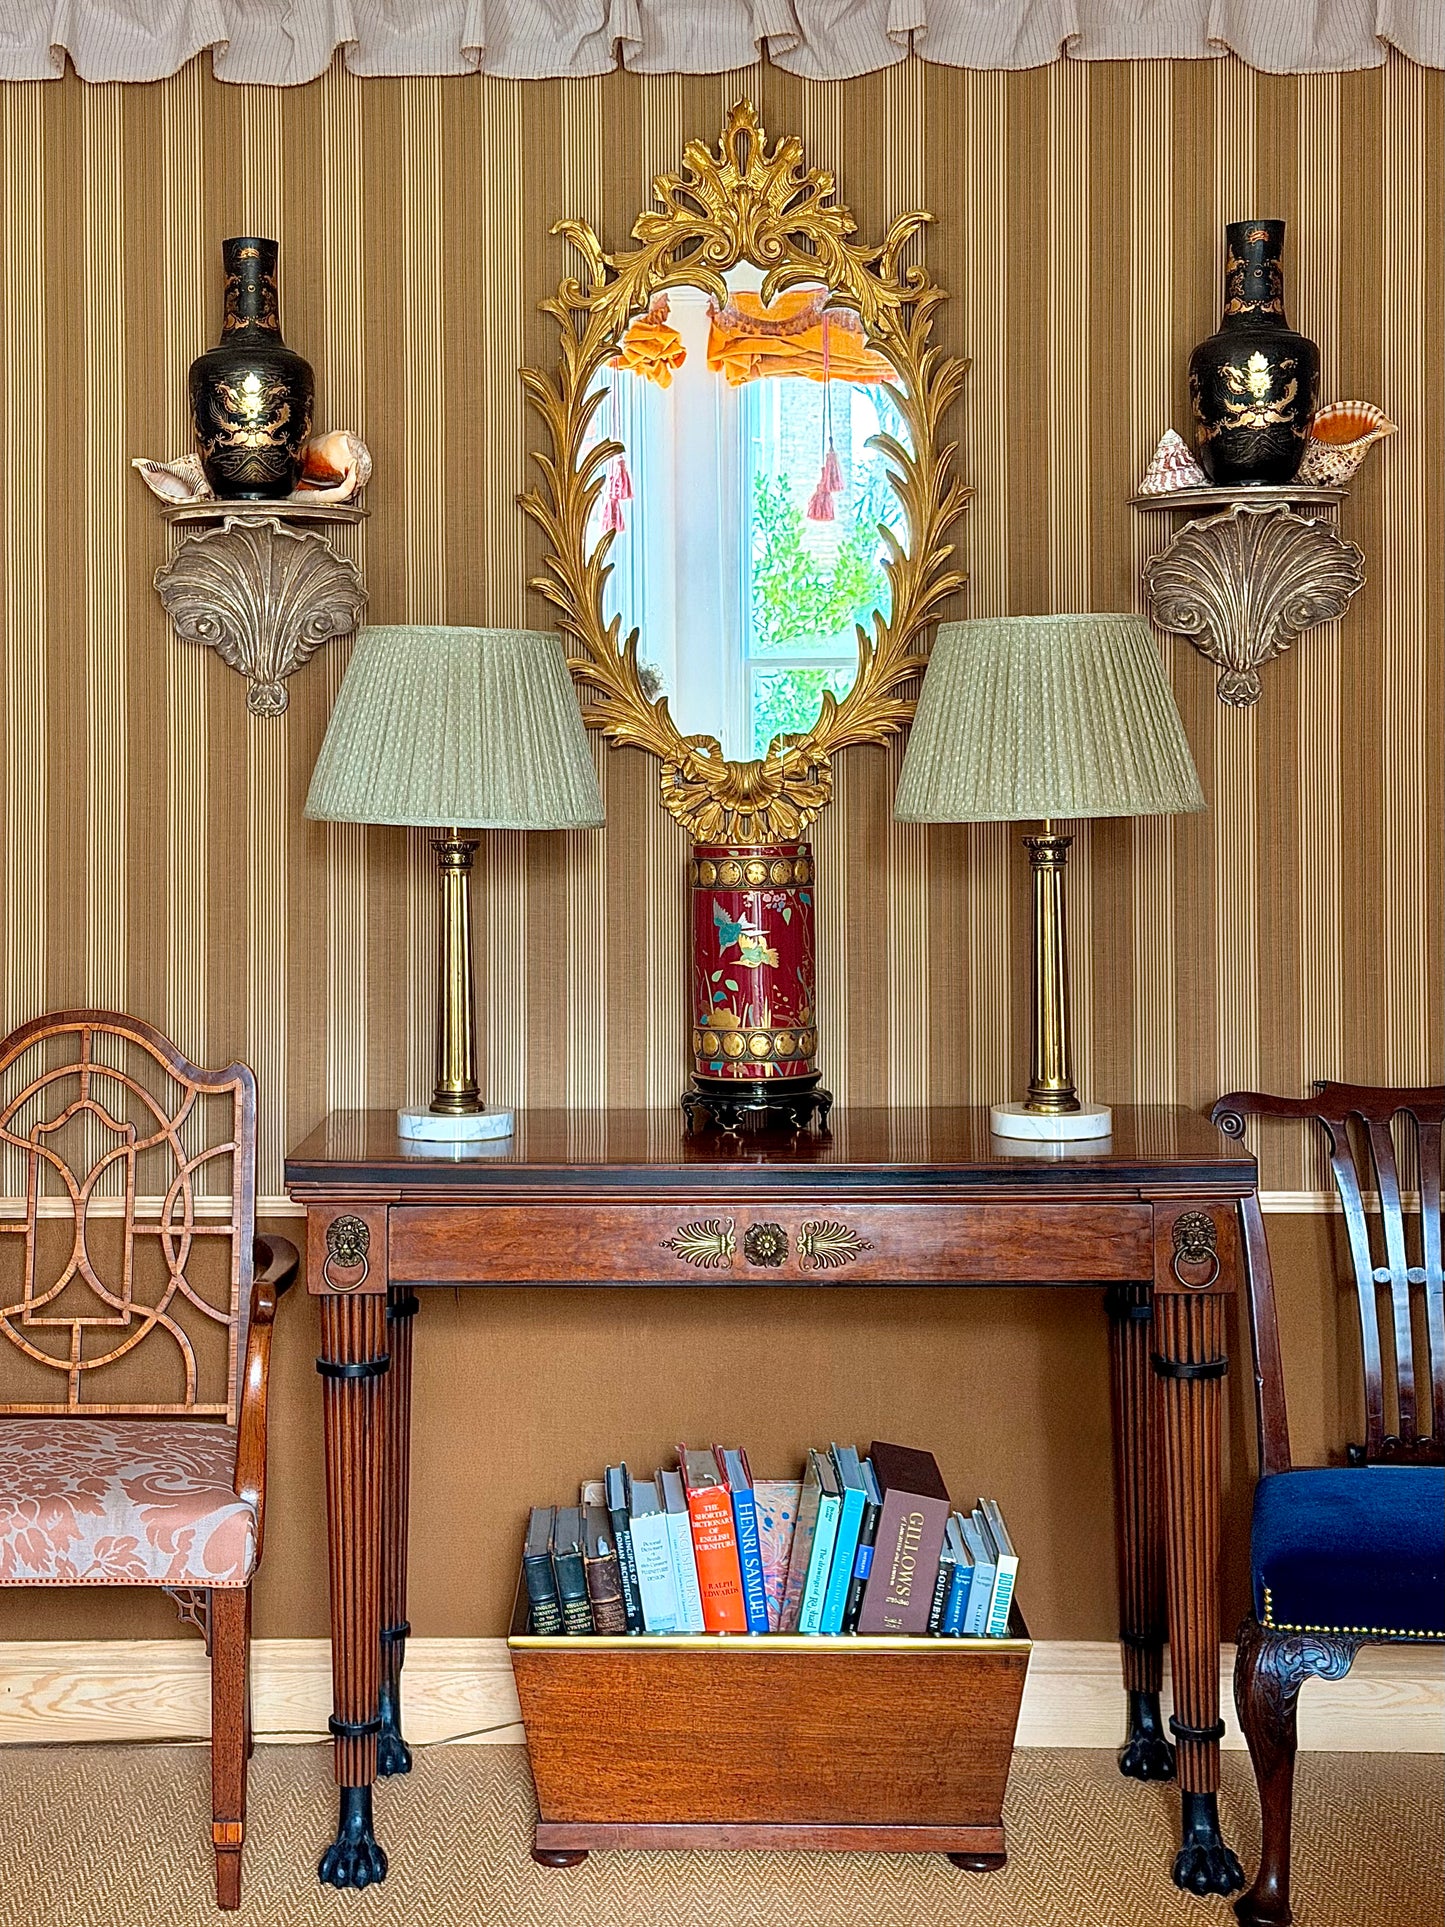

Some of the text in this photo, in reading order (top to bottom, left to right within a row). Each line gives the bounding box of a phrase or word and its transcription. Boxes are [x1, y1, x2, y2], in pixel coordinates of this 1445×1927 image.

[694, 1510, 728, 1520] SHORTER
[703, 1504, 719, 1512] THE
[677, 1524, 693, 1572] ENGLISH
[695, 1541, 735, 1551] FURNITURE
[699, 1533, 730, 1543] ENGLISH
[623, 1530, 638, 1585] PRINCIPLES OF
[738, 1503, 765, 1623] HENRI SAMUEL
[896, 1512, 925, 1597] GILLOWS
[615, 1531, 635, 1618] ROMAN ARCHITECTURE
[708, 1581, 733, 1590] RALPH
[703, 1588, 739, 1598] EDWARDS
[930, 1569, 947, 1629] SOUTHERN
